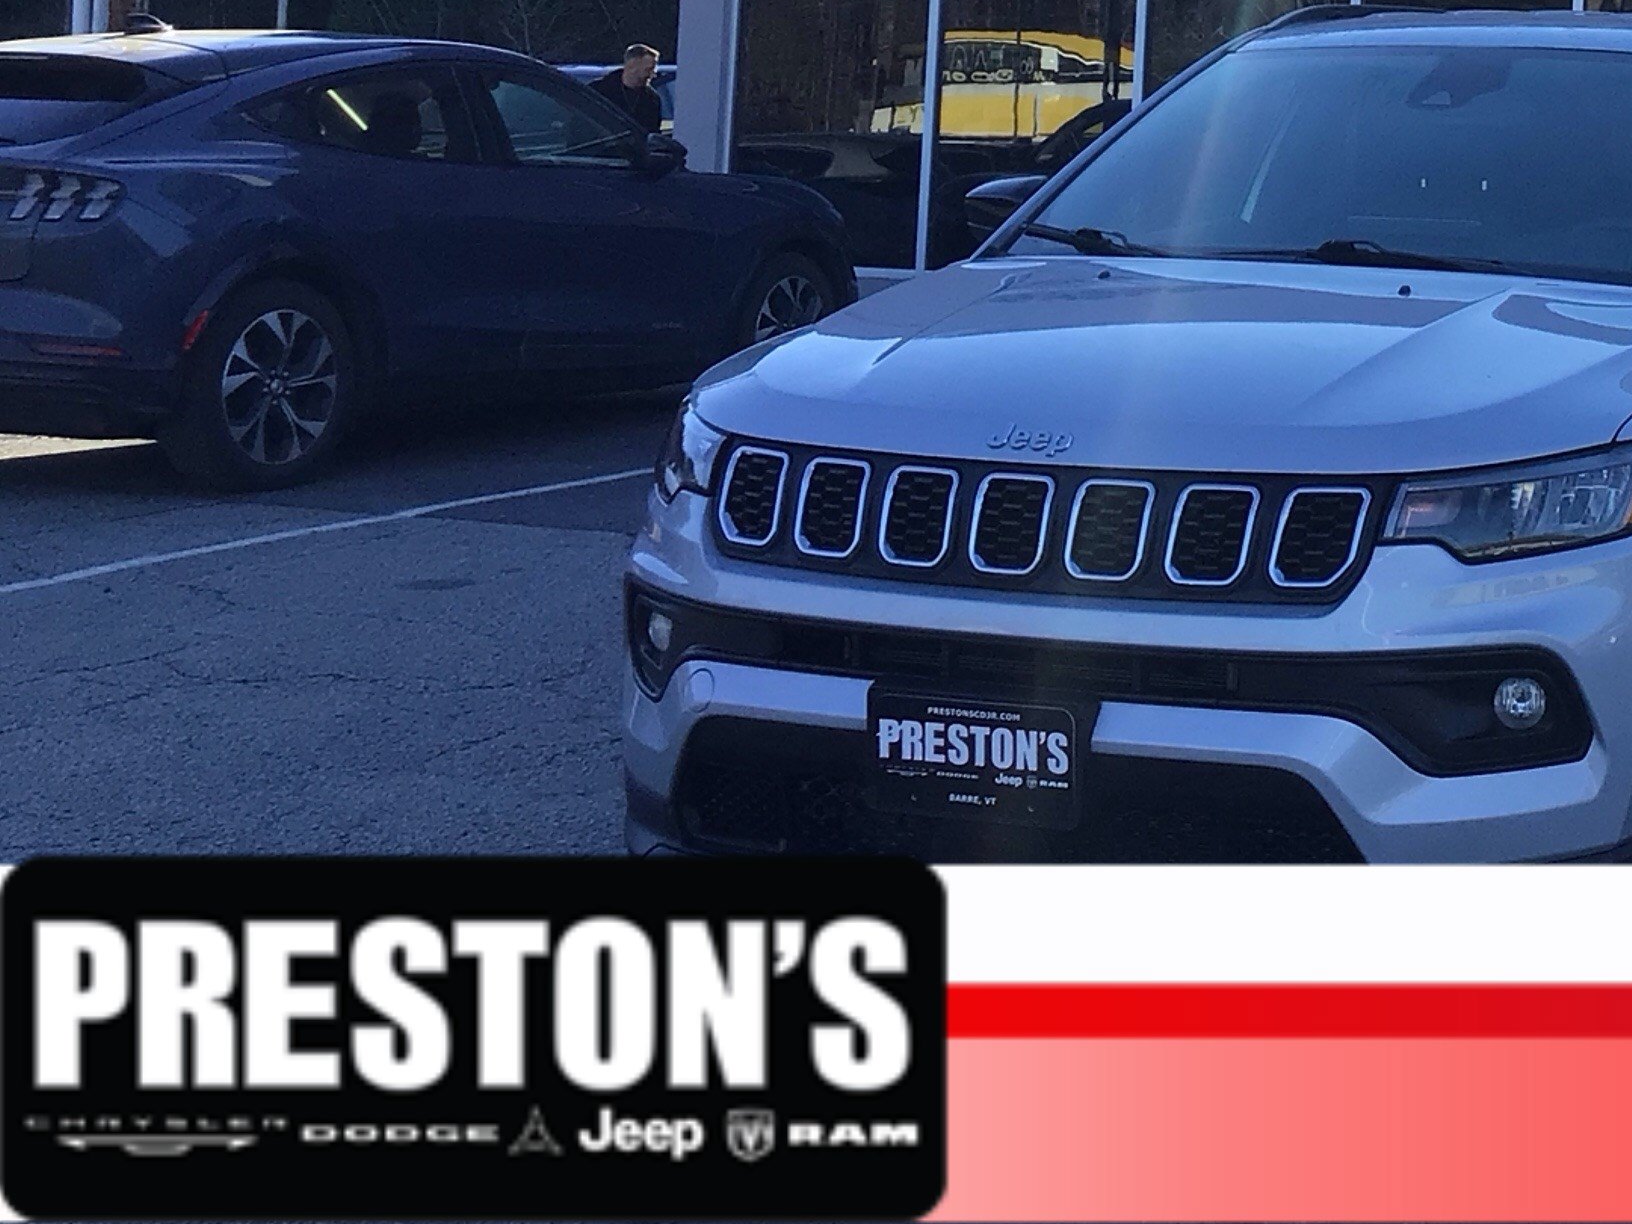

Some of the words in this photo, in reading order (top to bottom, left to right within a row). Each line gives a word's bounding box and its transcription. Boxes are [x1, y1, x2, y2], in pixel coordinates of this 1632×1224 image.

[986, 423, 1074, 458] Jeep
[927, 707, 1021, 722] PRESTONSCDJR.COM
[877, 718, 1069, 775] PRESTON'S
[995, 773, 1023, 787] Jeep
